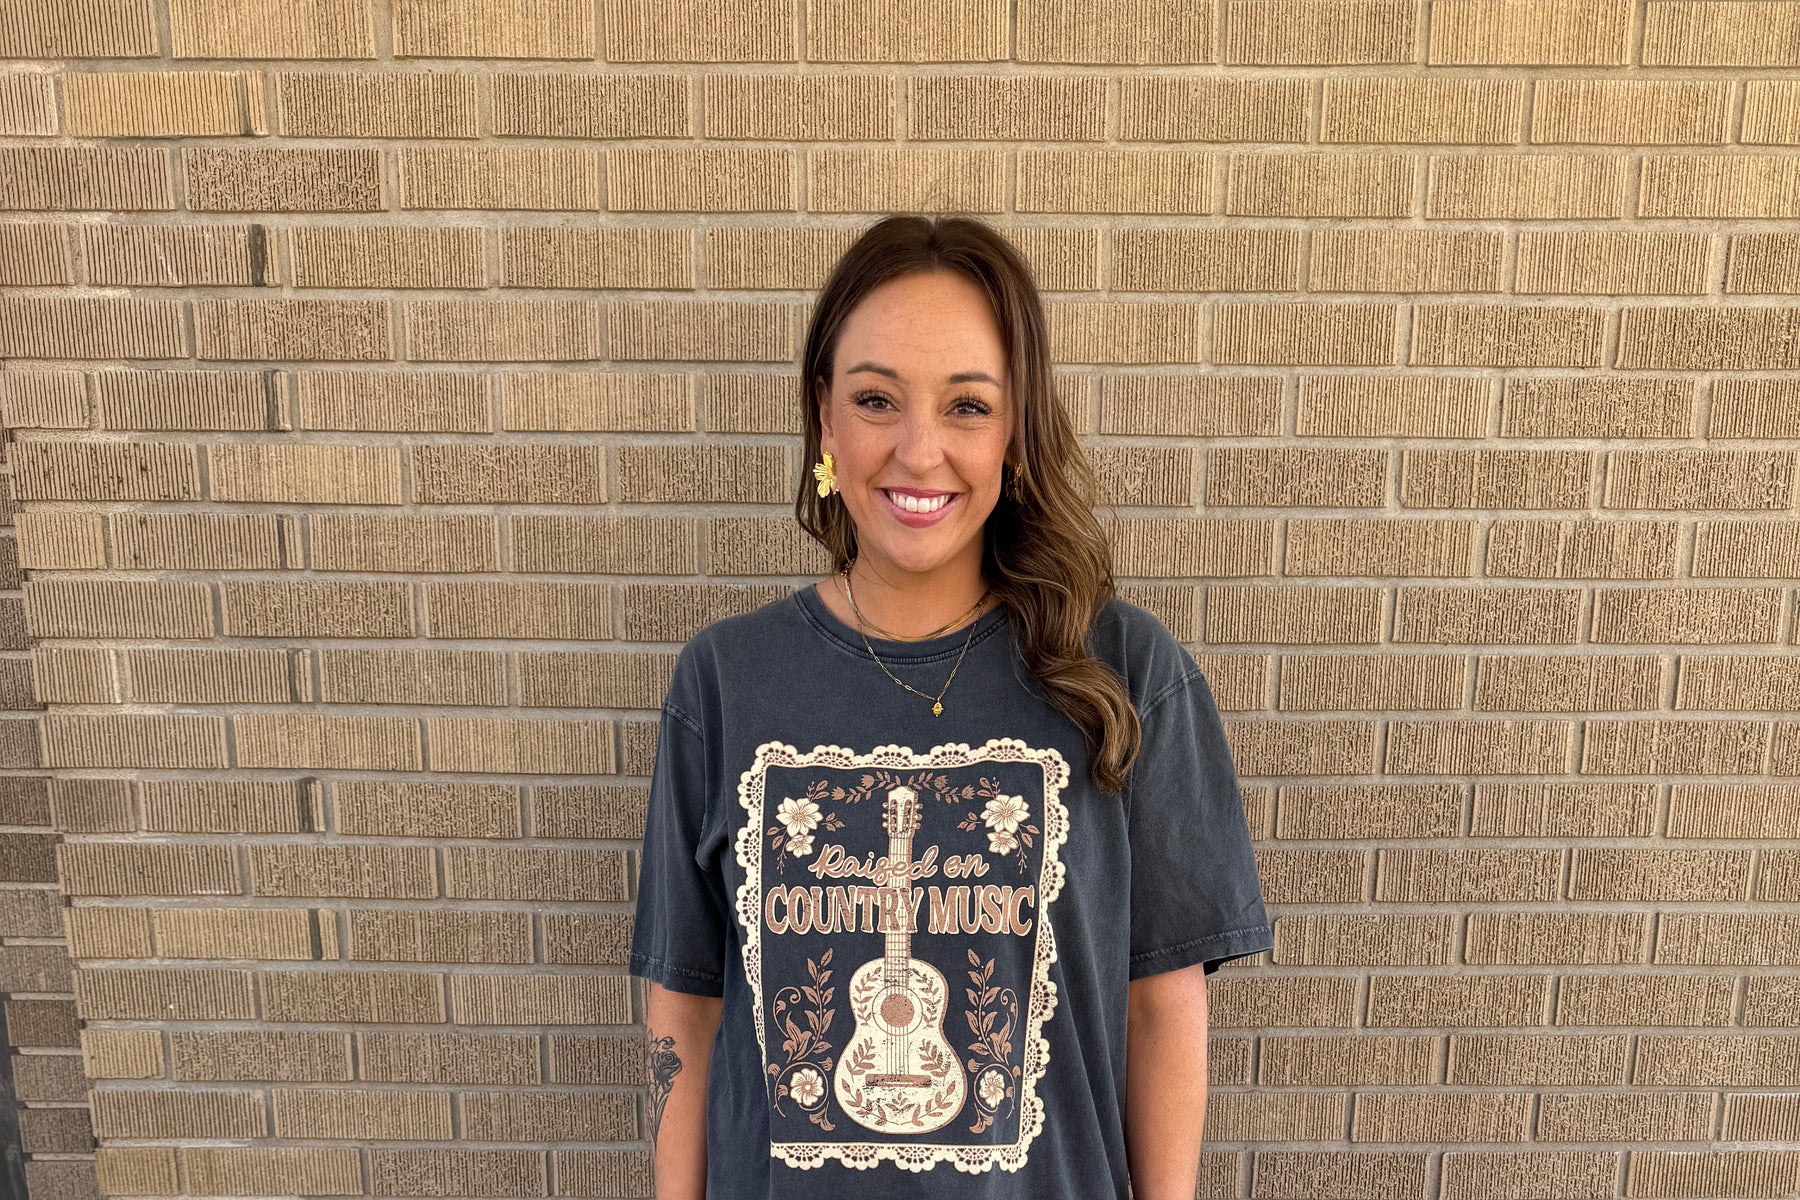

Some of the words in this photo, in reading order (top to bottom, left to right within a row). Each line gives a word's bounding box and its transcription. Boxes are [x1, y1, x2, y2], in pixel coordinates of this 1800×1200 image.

[808, 844, 939, 886] Raised
[943, 853, 989, 878] on
[765, 884, 924, 935] COUNTRY
[927, 884, 1034, 936] MUSIC
